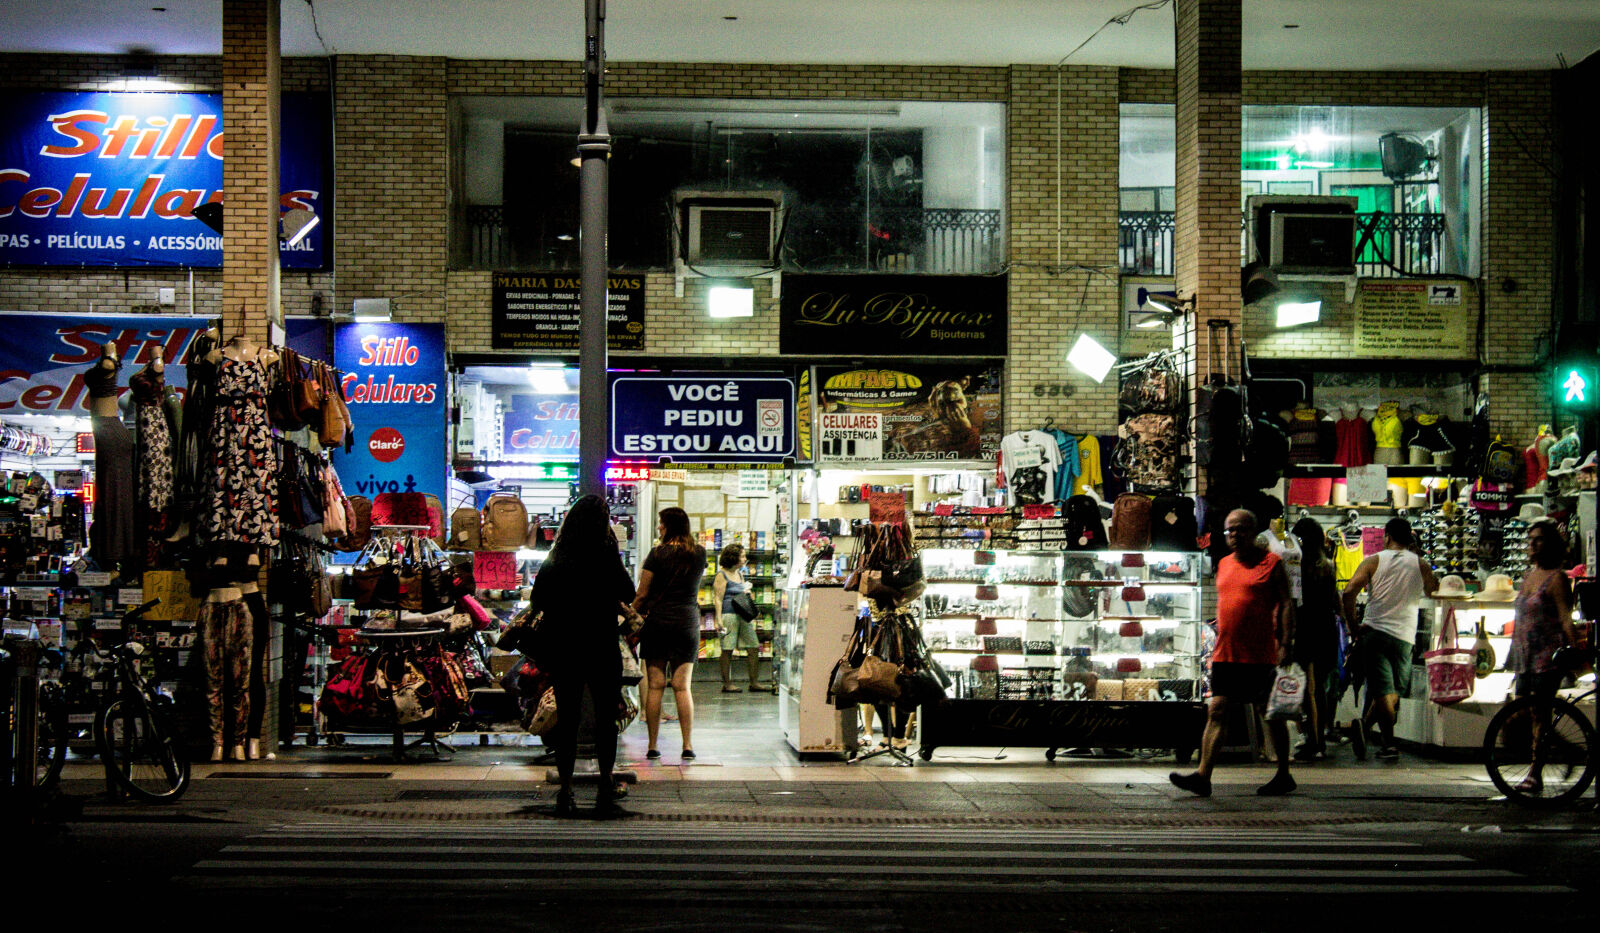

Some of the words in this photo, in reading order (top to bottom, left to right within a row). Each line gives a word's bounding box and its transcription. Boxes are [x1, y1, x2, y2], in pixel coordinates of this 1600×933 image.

[0, 234, 30, 249] PAS
[48, 231, 126, 250] PELÍCULAS
[148, 232, 224, 251] ACESSÓRI
[279, 238, 314, 252] ERAL
[497, 277, 548, 288] MARIA
[930, 329, 986, 341] Bijouterias
[358, 335, 420, 367] Stillo
[341, 371, 437, 405] Celulares
[823, 369, 923, 390] IMPACTO
[667, 380, 740, 402] VOCÊ
[827, 390, 879, 399] Informáticas
[880, 391, 888, 399] &
[889, 390, 918, 399] Games
[664, 409, 744, 427] PEDIU
[823, 415, 878, 429] CELULARES
[511, 428, 580, 449] Celul
[823, 428, 878, 440] ASSISTÊNCIA
[369, 439, 401, 450] Claro
[623, 434, 711, 452] ESTOU
[718, 434, 784, 453] AQUI
[356, 473, 400, 495] vivo
[1475, 492, 1508, 502] TOMMY
